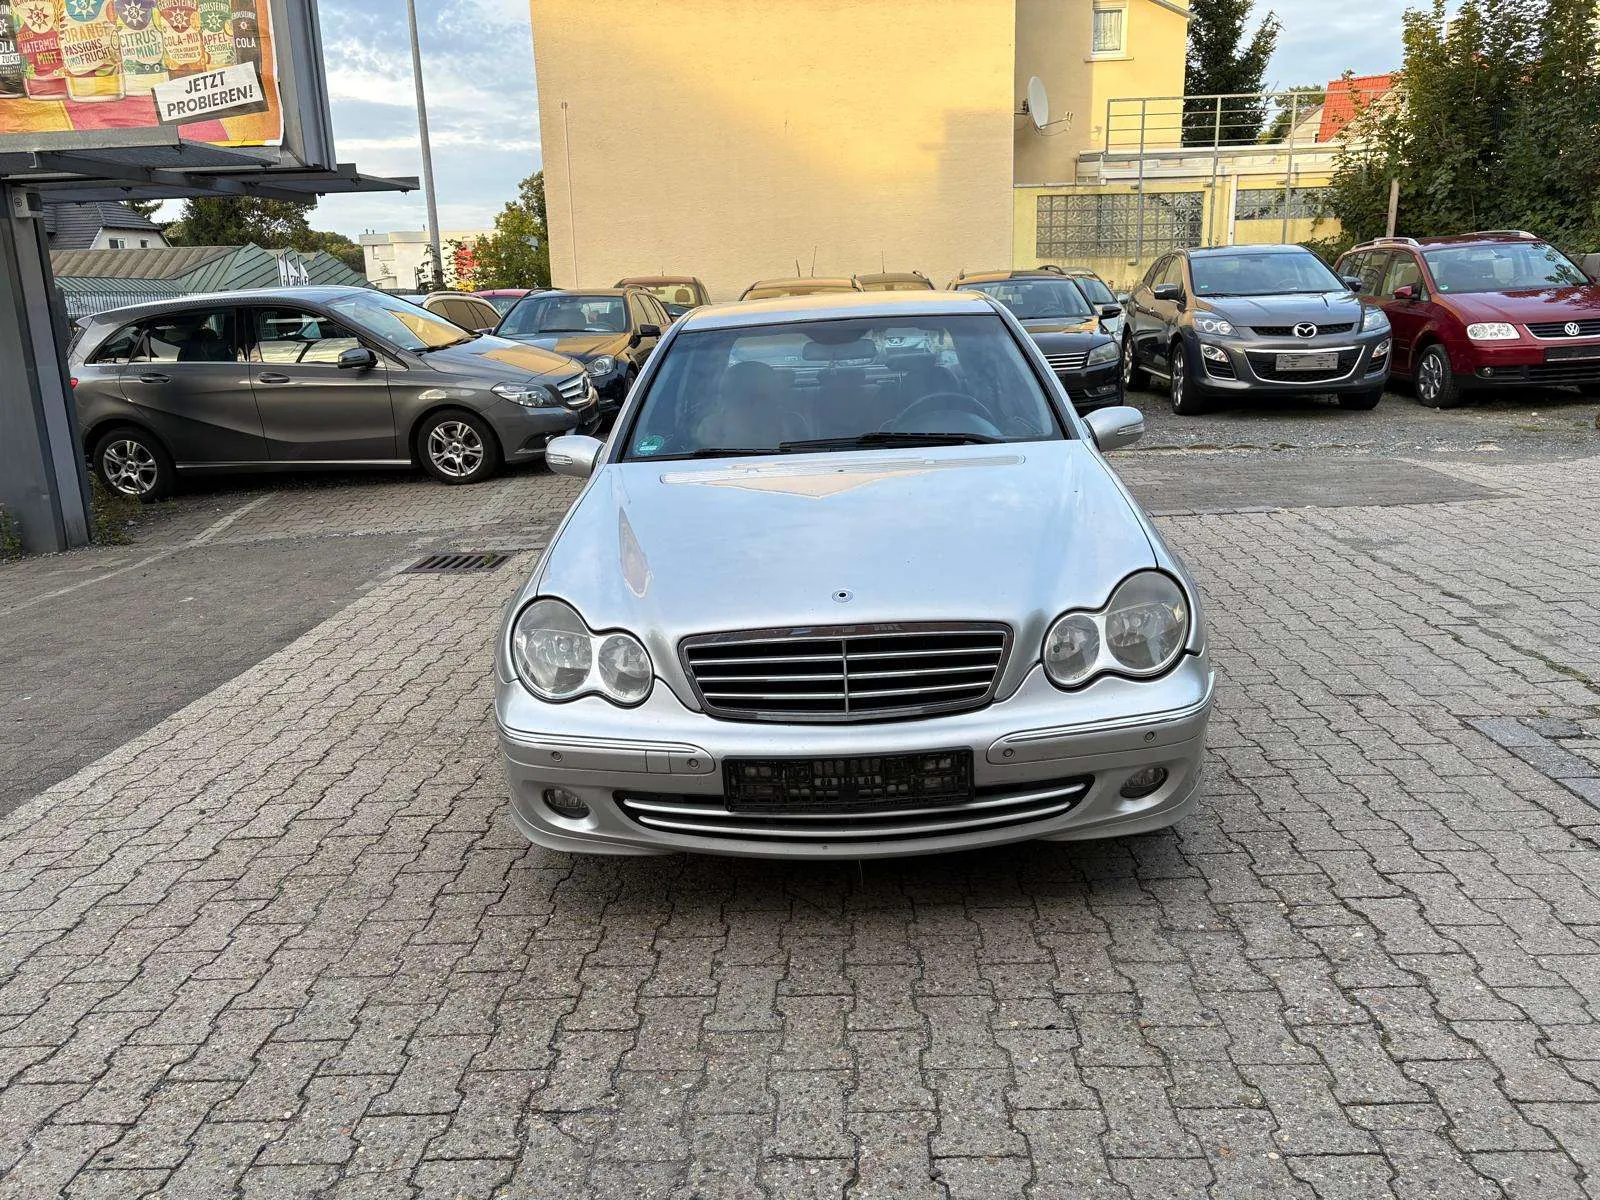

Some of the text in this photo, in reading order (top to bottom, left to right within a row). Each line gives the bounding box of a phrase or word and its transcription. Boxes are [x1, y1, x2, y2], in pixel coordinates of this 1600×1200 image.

[0, 40, 15, 53] OLA
[120, 29, 157, 48] CITRUS
[164, 32, 200, 48] COLA-MIX
[203, 32, 227, 46] APFEL
[236, 37, 257, 48] COLA
[64, 38, 103, 57] PASSIONS
[80, 46, 111, 65] FRUCHT
[135, 42, 161, 58] MINZE
[36, 51, 58, 65] MINT
[185, 71, 226, 94] JETZT
[167, 85, 254, 117] PROBIEREN!
